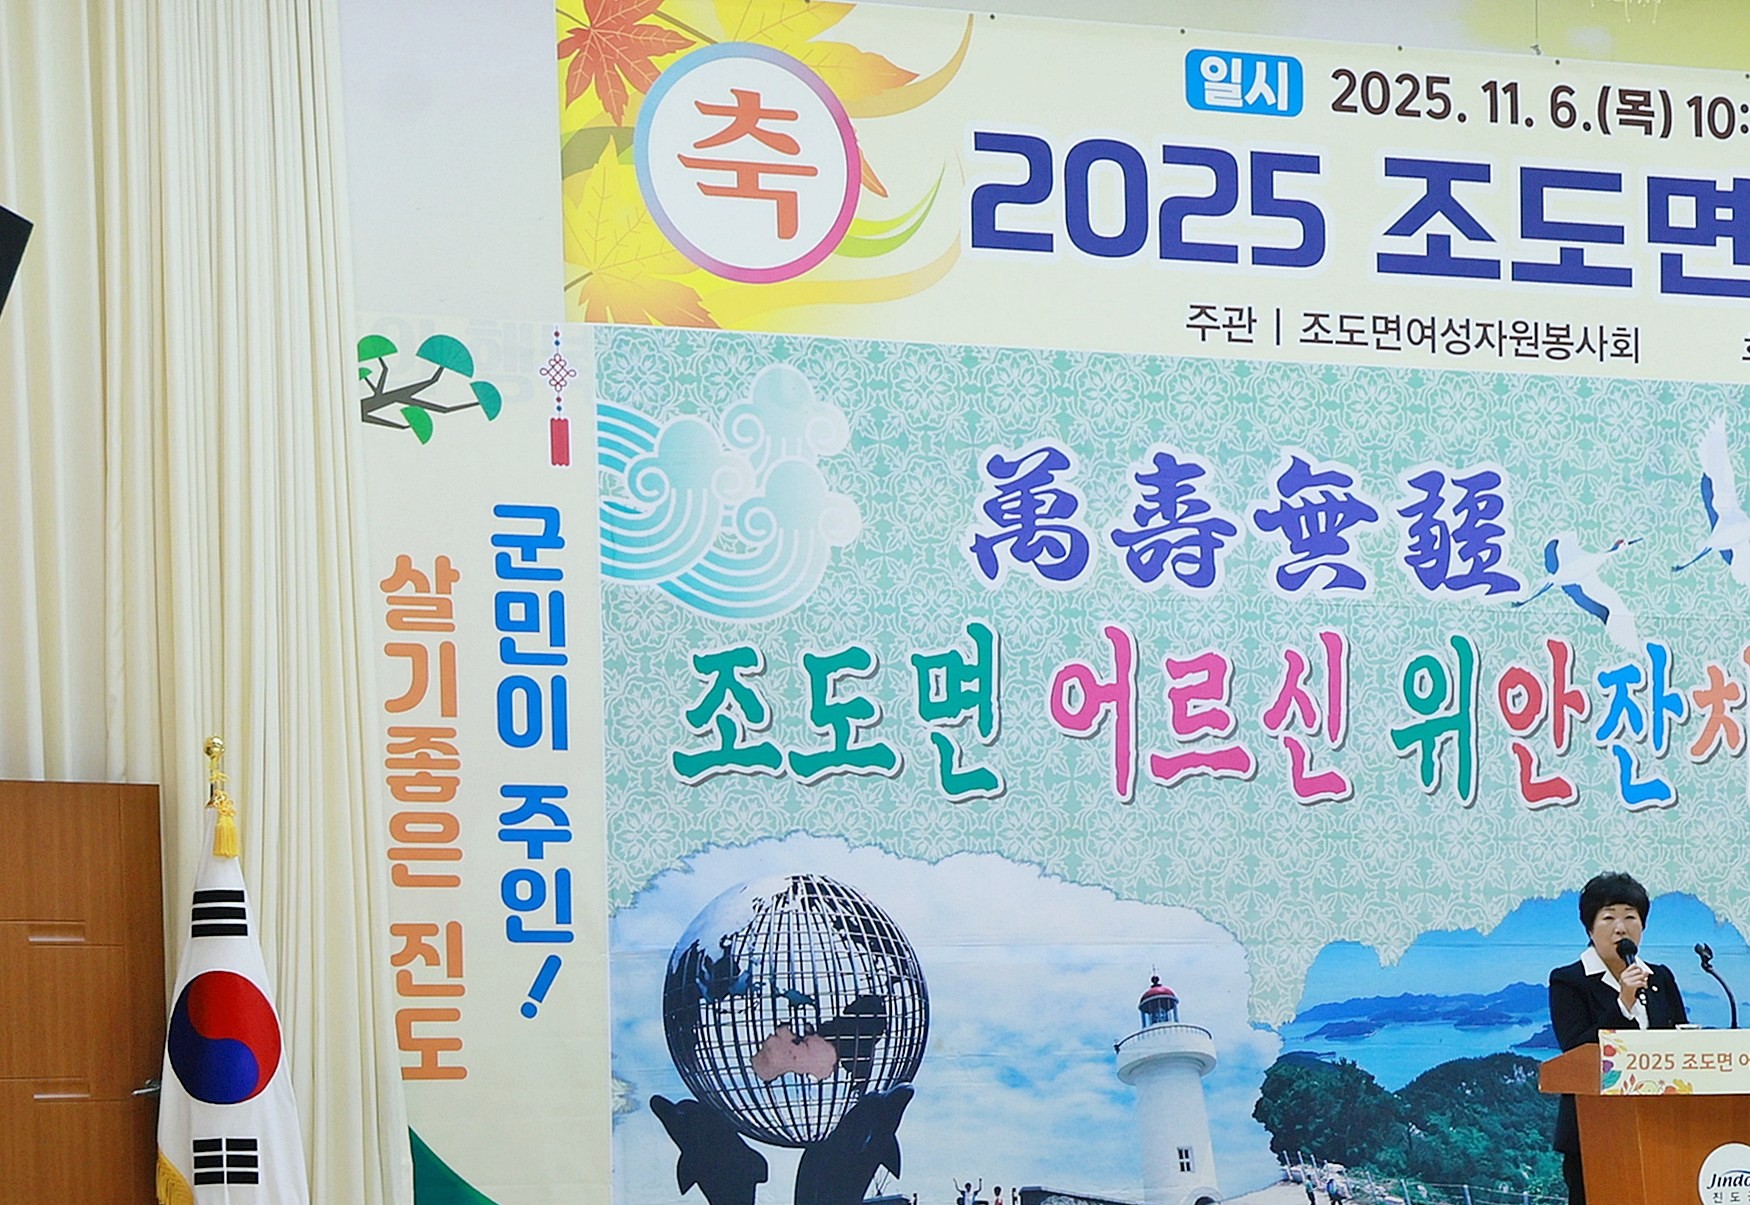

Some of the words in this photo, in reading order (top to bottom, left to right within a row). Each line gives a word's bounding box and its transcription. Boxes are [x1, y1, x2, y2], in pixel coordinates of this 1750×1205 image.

[677, 88, 818, 240] 축
[1199, 55, 1290, 112] 일시
[1331, 67, 1467, 124] 2025.
[1481, 80, 1534, 128] 11.
[1550, 84, 1673, 139] 6.(목)
[971, 131, 1326, 269] 2025
[1186, 303, 1258, 345] 주관
[1300, 309, 1642, 364] 조도면여성자원봉사회
[968, 446, 1522, 596] 萬壽無疆
[491, 503, 569, 751] 군민이
[380, 554, 464, 889] 살기좋은
[672, 622, 1000, 797] 조도면
[1050, 625, 1347, 799] 어르신
[389, 920, 468, 1081] 진도
[1626, 1053, 1675, 1071] 2025
[1682, 1052, 1733, 1072] 조도면
